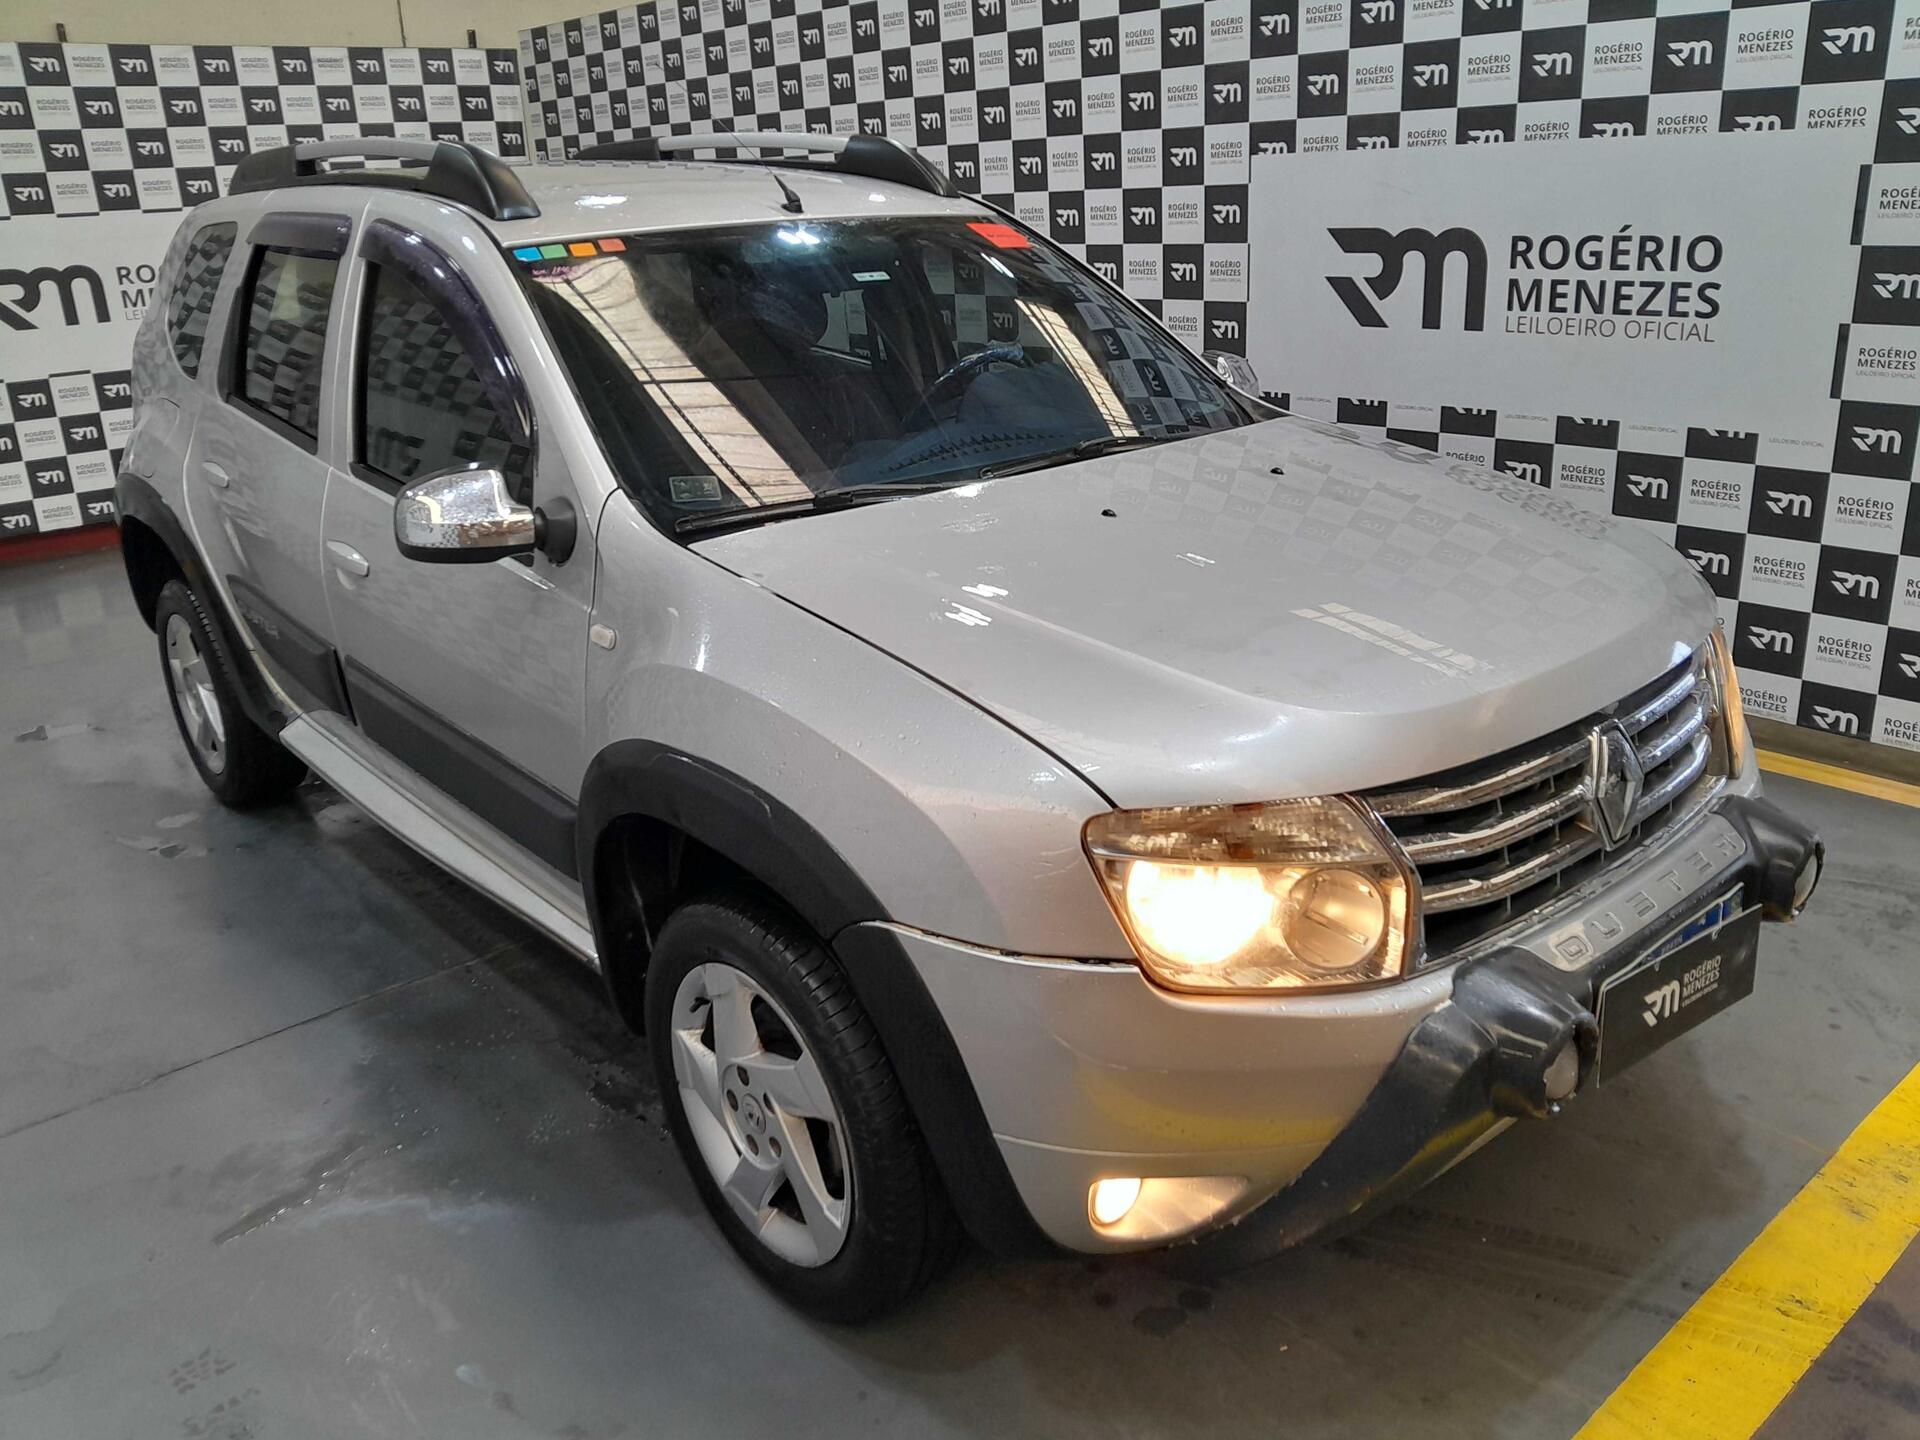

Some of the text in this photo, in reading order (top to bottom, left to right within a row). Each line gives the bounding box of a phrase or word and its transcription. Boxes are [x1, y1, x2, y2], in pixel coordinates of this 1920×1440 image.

[681, 4, 696, 20] RM
[977, 0, 999, 16] RM
[1306, 3, 1342, 15] ROGÉRIO
[1360, 0, 1394, 23] RM
[914, 7, 934, 26] RM
[1259, 12, 1289, 35] RM
[1305, 12, 1343, 25] MENEZES
[603, 21, 616, 36] RM
[855, 18, 874, 36] RM
[1738, 27, 1794, 43] ROGÉRIO
[753, 36, 769, 52] RM
[1169, 25, 1196, 47] RM
[1821, 24, 1875, 54] RM
[1087, 36, 1112, 56] RM
[1594, 40, 1643, 55] ROGÉRIO
[1666, 38, 1713, 66] RM
[1737, 40, 1793, 54] MENEZES
[28, 57, 59, 71] RM
[1014, 46, 1037, 66] RM
[1468, 52, 1510, 66] ROGÉRIO
[1531, 50, 1572, 76] RM
[1593, 52, 1642, 66] MENEZES
[118, 58, 147, 72] RM
[281, 59, 306, 72] RM
[426, 60, 448, 72] RM
[887, 64, 907, 82] RM
[948, 56, 969, 74] RM
[1356, 63, 1393, 76] ROGÉRIO
[1467, 63, 1510, 76] MENEZES
[832, 71, 850, 88] RM
[1355, 74, 1393, 85] MENEZES
[1412, 62, 1448, 86] RM
[1307, 72, 1338, 95] RM
[1128, 90, 1153, 110] RM
[1212, 81, 1240, 103] RM
[83, 100, 113, 114] RM
[249, 98, 275, 111] RM
[396, 97, 419, 109] RM
[651, 97, 664, 111] RM
[1052, 98, 1075, 117] RM
[983, 105, 1004, 123] RM
[1657, 112, 1708, 126] ROGÉRIO
[1808, 104, 1867, 119] ROGÉRIO
[920, 111, 940, 129] RM
[1524, 120, 1569, 132] ROGÉRIO
[1407, 127, 1447, 139] ROGÉRIO
[48, 143, 79, 157] RM
[217, 138, 244, 152] RM
[1090, 151, 1114, 170] RM
[1169, 146, 1196, 166] RM
[954, 160, 974, 177] RM
[1019, 156, 1041, 174] RM
[101, 183, 130, 197] RM
[1881, 185, 1920, 199] ROGÉ
[1055, 208, 1078, 225] RM
[1130, 206, 1154, 224] RM
[1212, 204, 1239, 223] RM
[1509, 224, 1723, 273] ROGÉRIO
[1170, 263, 1195, 281] RM
[1325, 227, 1488, 331] RM
[1507, 277, 1722, 319] MENEZES
[1211, 320, 1238, 338] RM
[1505, 316, 1715, 343] LEILOEIRO OFICIAL
[1858, 346, 1917, 359] ROGÉRIO
[1856, 358, 1915, 370] MENEZES
[16, 392, 46, 407] RM
[69, 425, 97, 440] RM
[1850, 426, 1902, 453] RM
[35, 469, 64, 484] RM
[1561, 464, 1605, 476] ROGÉRIO
[1560, 473, 1604, 485] MENEZES
[1627, 474, 1668, 499] RM
[1691, 478, 1741, 492] ROGÉRIO
[1690, 488, 1739, 502] MENEZES
[1837, 495, 1894, 510] ROGÉRIO
[1765, 490, 1812, 517] RM
[0, 513, 30, 528] RM
[1836, 505, 1893, 521] MENEZES
[1754, 555, 1806, 571] ROGÉRIO
[1752, 565, 1804, 581] MENEZES
[1830, 570, 1879, 599] RM
[1748, 625, 1793, 653] RM
[1818, 635, 1872, 652] ROGÉRIO
[1816, 644, 1871, 662] MENEZES
[1811, 704, 1859, 735] RM
[1884, 718, 1920, 733] ROGÉ
[1555, 832, 1737, 960] DUSTER
[1683, 954, 1722, 985] ROGÉRIO
[1682, 967, 1720, 999] MENEZES
[1642, 979, 1681, 1027] RM
